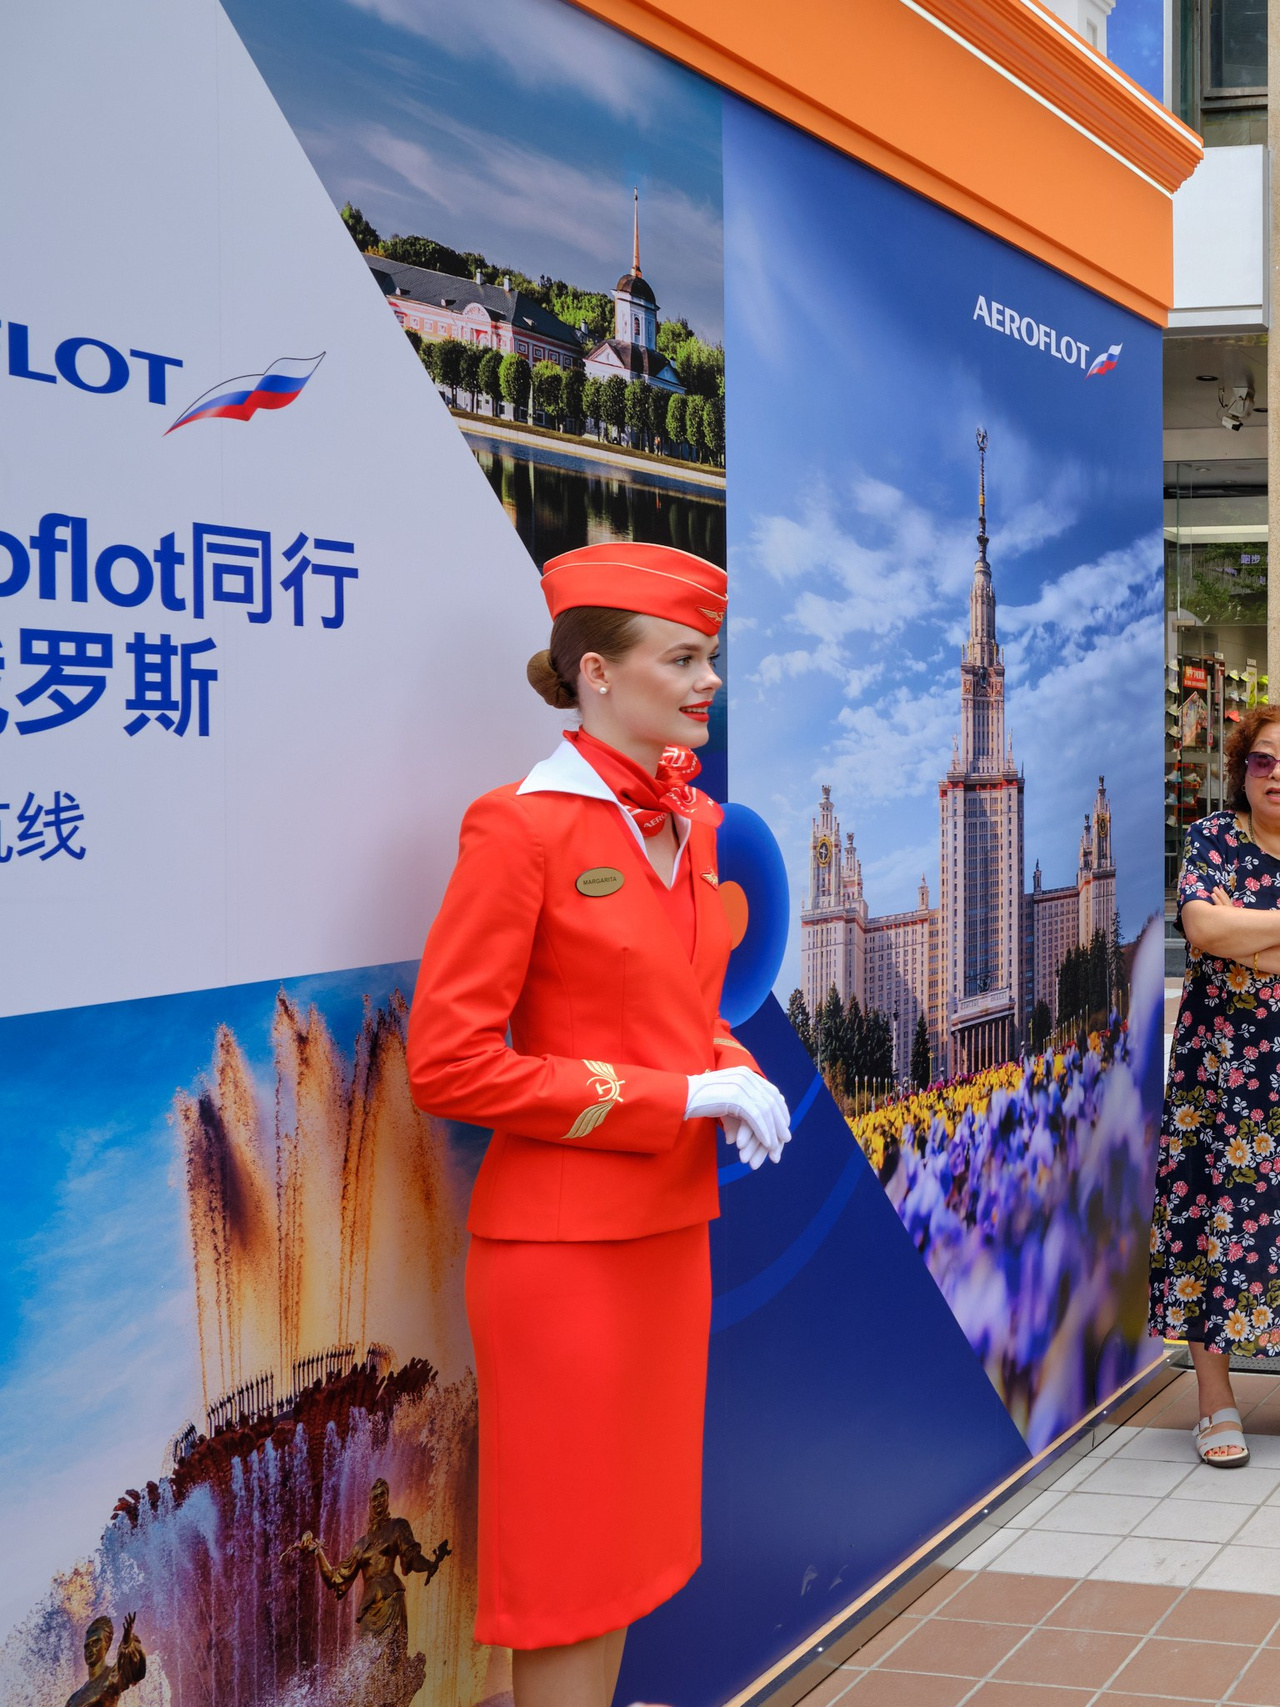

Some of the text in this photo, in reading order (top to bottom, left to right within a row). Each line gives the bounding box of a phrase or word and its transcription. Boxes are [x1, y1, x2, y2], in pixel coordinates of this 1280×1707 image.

[0, 319, 183, 405] LOT
[973, 295, 1090, 369] AEROFLOT
[0, 628, 218, 737] 罗斯
[0, 791, 87, 863] 线
[582, 876, 617, 886] MARGARITA
